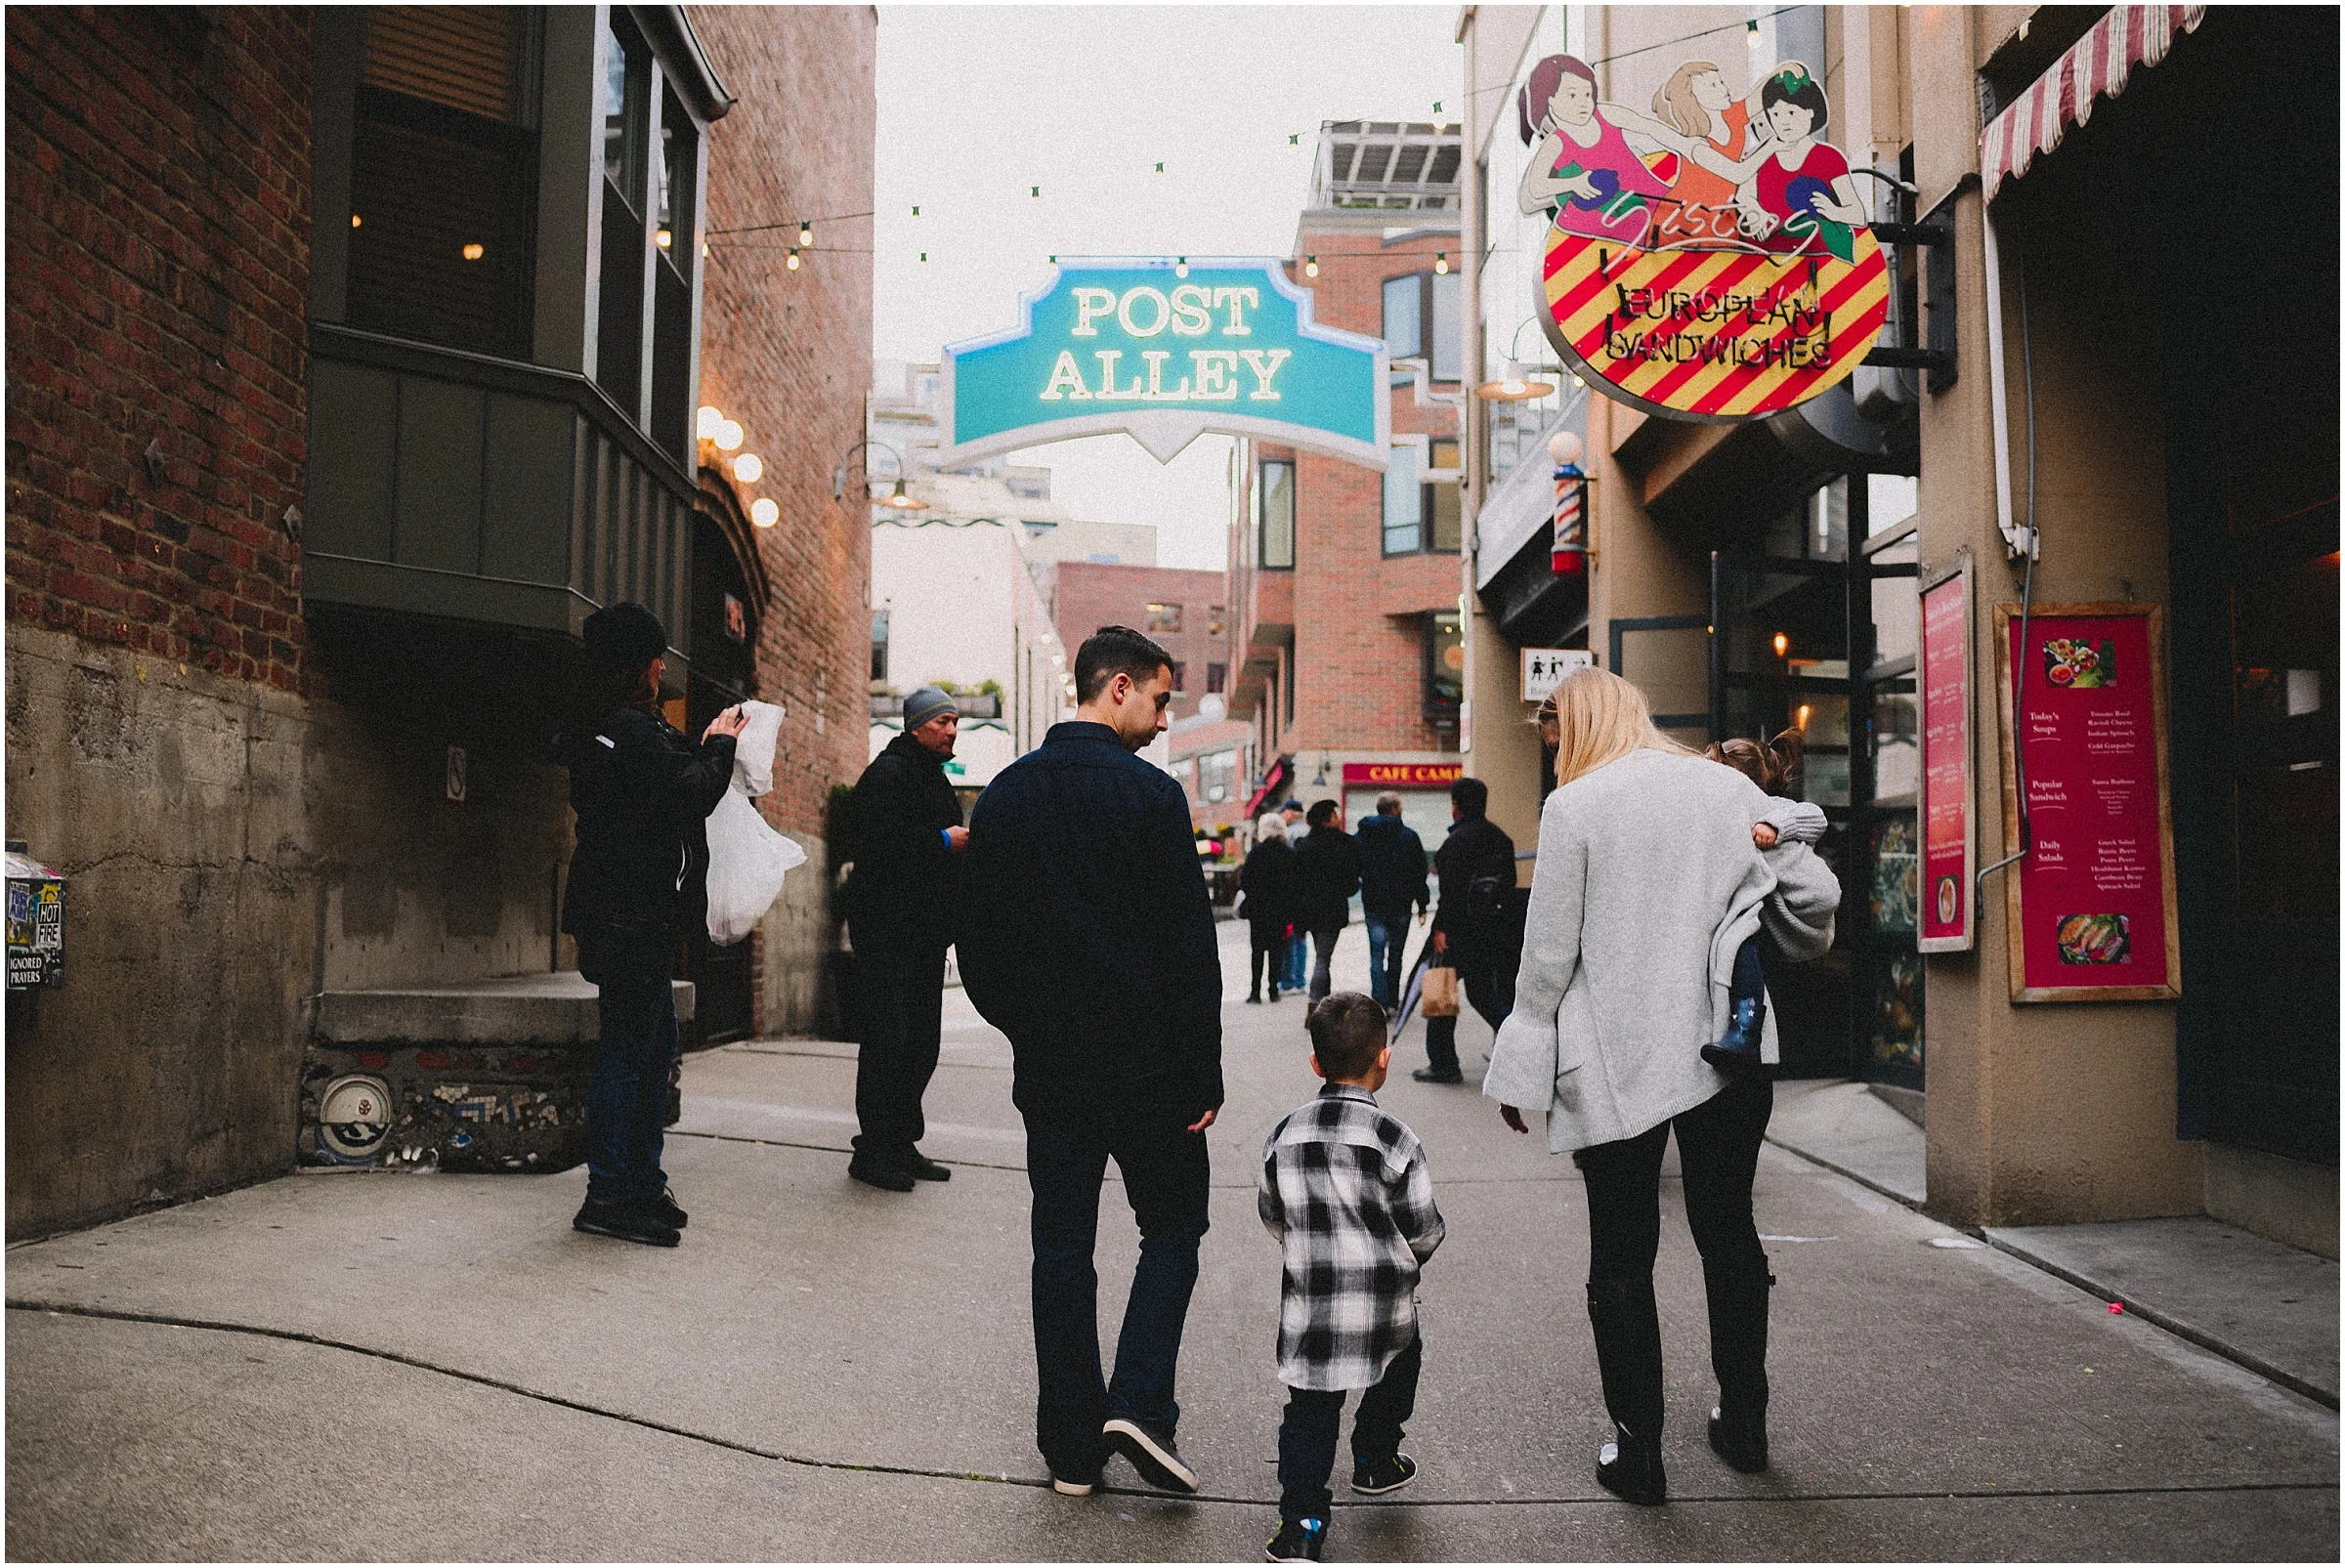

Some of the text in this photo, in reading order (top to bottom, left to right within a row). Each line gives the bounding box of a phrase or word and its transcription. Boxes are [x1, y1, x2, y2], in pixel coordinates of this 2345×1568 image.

[1071, 284, 1258, 337] POST
[1622, 283, 1822, 327] EUROPEAN
[1605, 330, 1833, 370] SANDWICHES
[1040, 349, 1292, 401] ALLEY
[2029, 711, 2060, 722] Today's
[2032, 724, 2057, 735] Soups
[1369, 766, 1411, 781] CAFE
[2032, 780, 2063, 791] Popular
[2029, 792, 2067, 801] Sandwich
[2039, 840, 2061, 851] Daily
[2038, 853, 2064, 862] Salads
[39, 904, 59, 922] HOT
[39, 924, 59, 942] FIRE
[10, 957, 42, 970] IGNORED
[11, 971, 41, 984] PRAYERS
